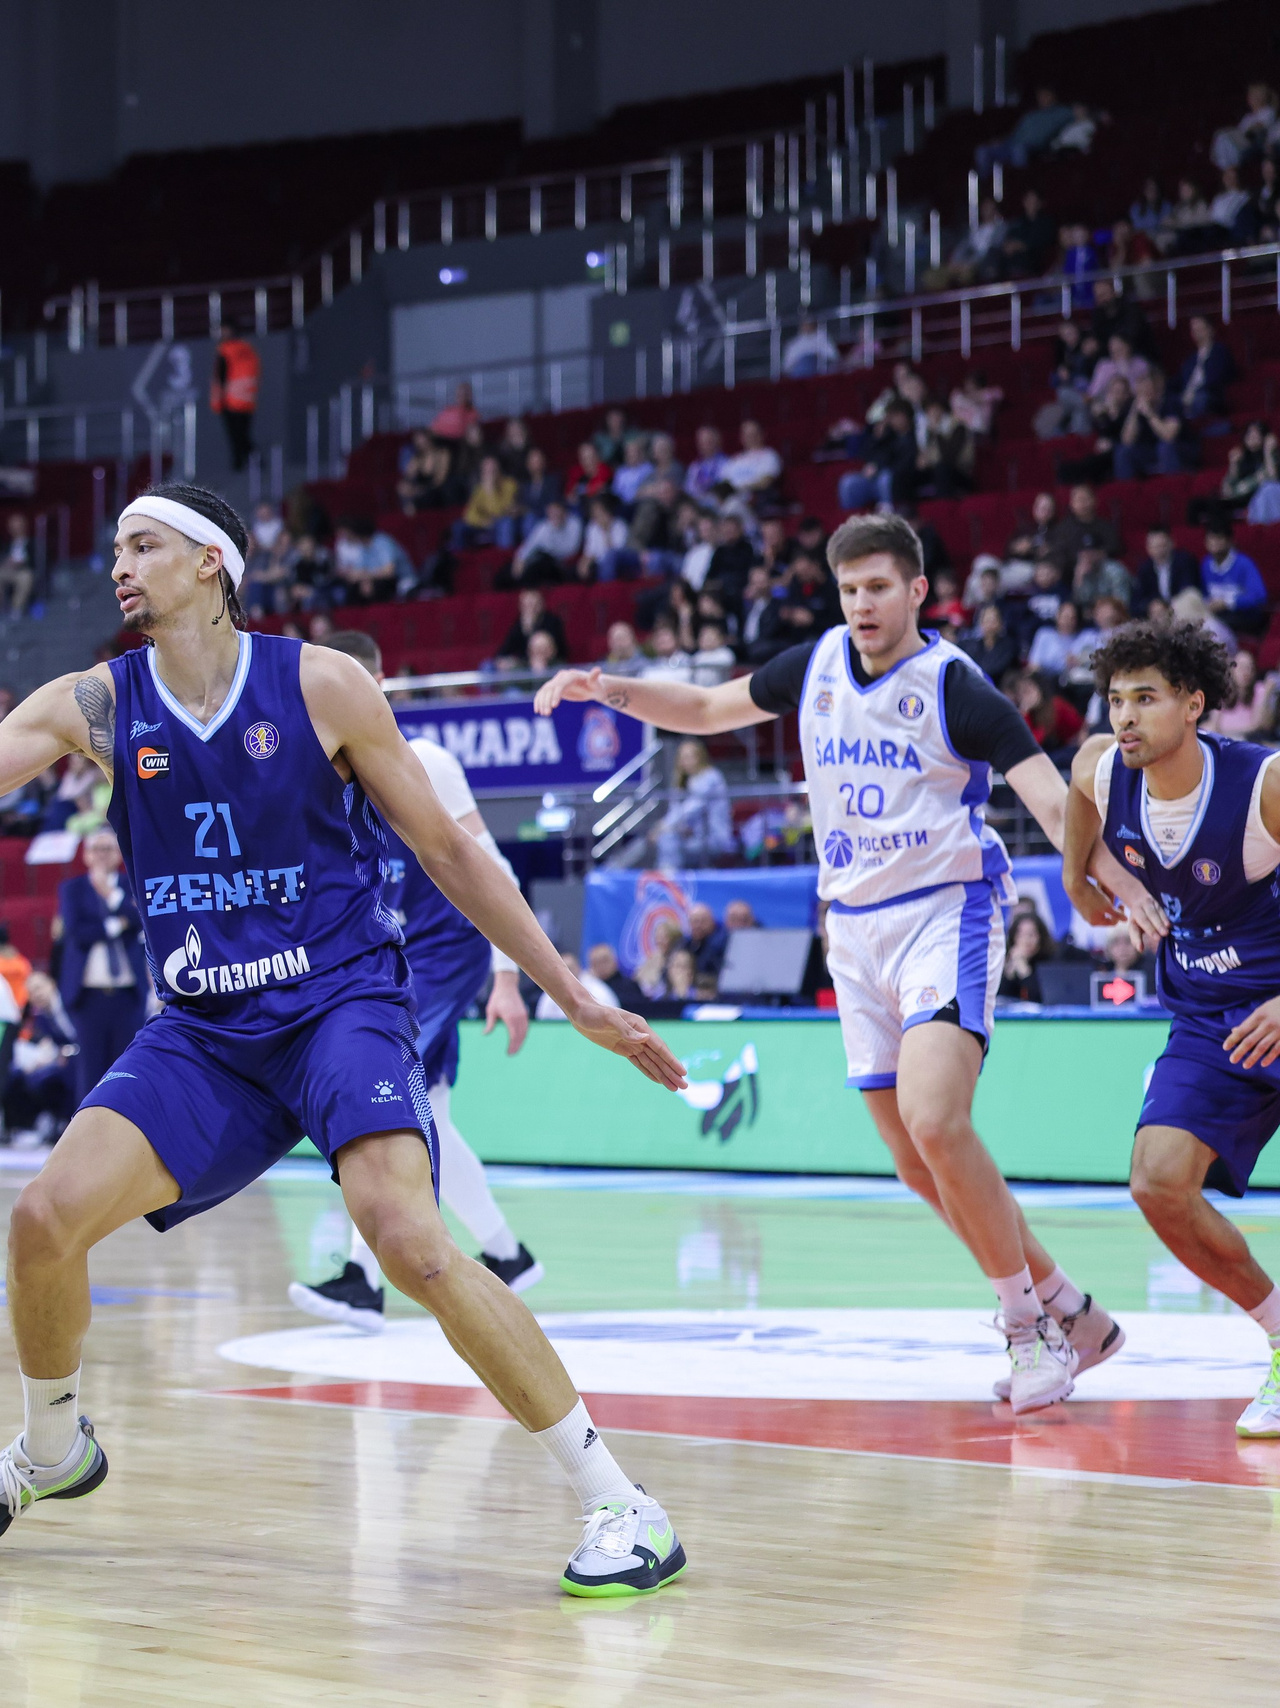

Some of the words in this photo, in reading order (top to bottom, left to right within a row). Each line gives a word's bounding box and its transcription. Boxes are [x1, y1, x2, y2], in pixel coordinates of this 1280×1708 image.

[145, 757, 169, 768] WIN
[404, 716, 563, 769] АМАРА
[839, 783, 885, 819] 20
[184, 802, 242, 859] 21
[144, 862, 307, 917] ZENIT
[208, 946, 311, 995] ГАЗПРОМ
[370, 1095, 403, 1104] KELME
